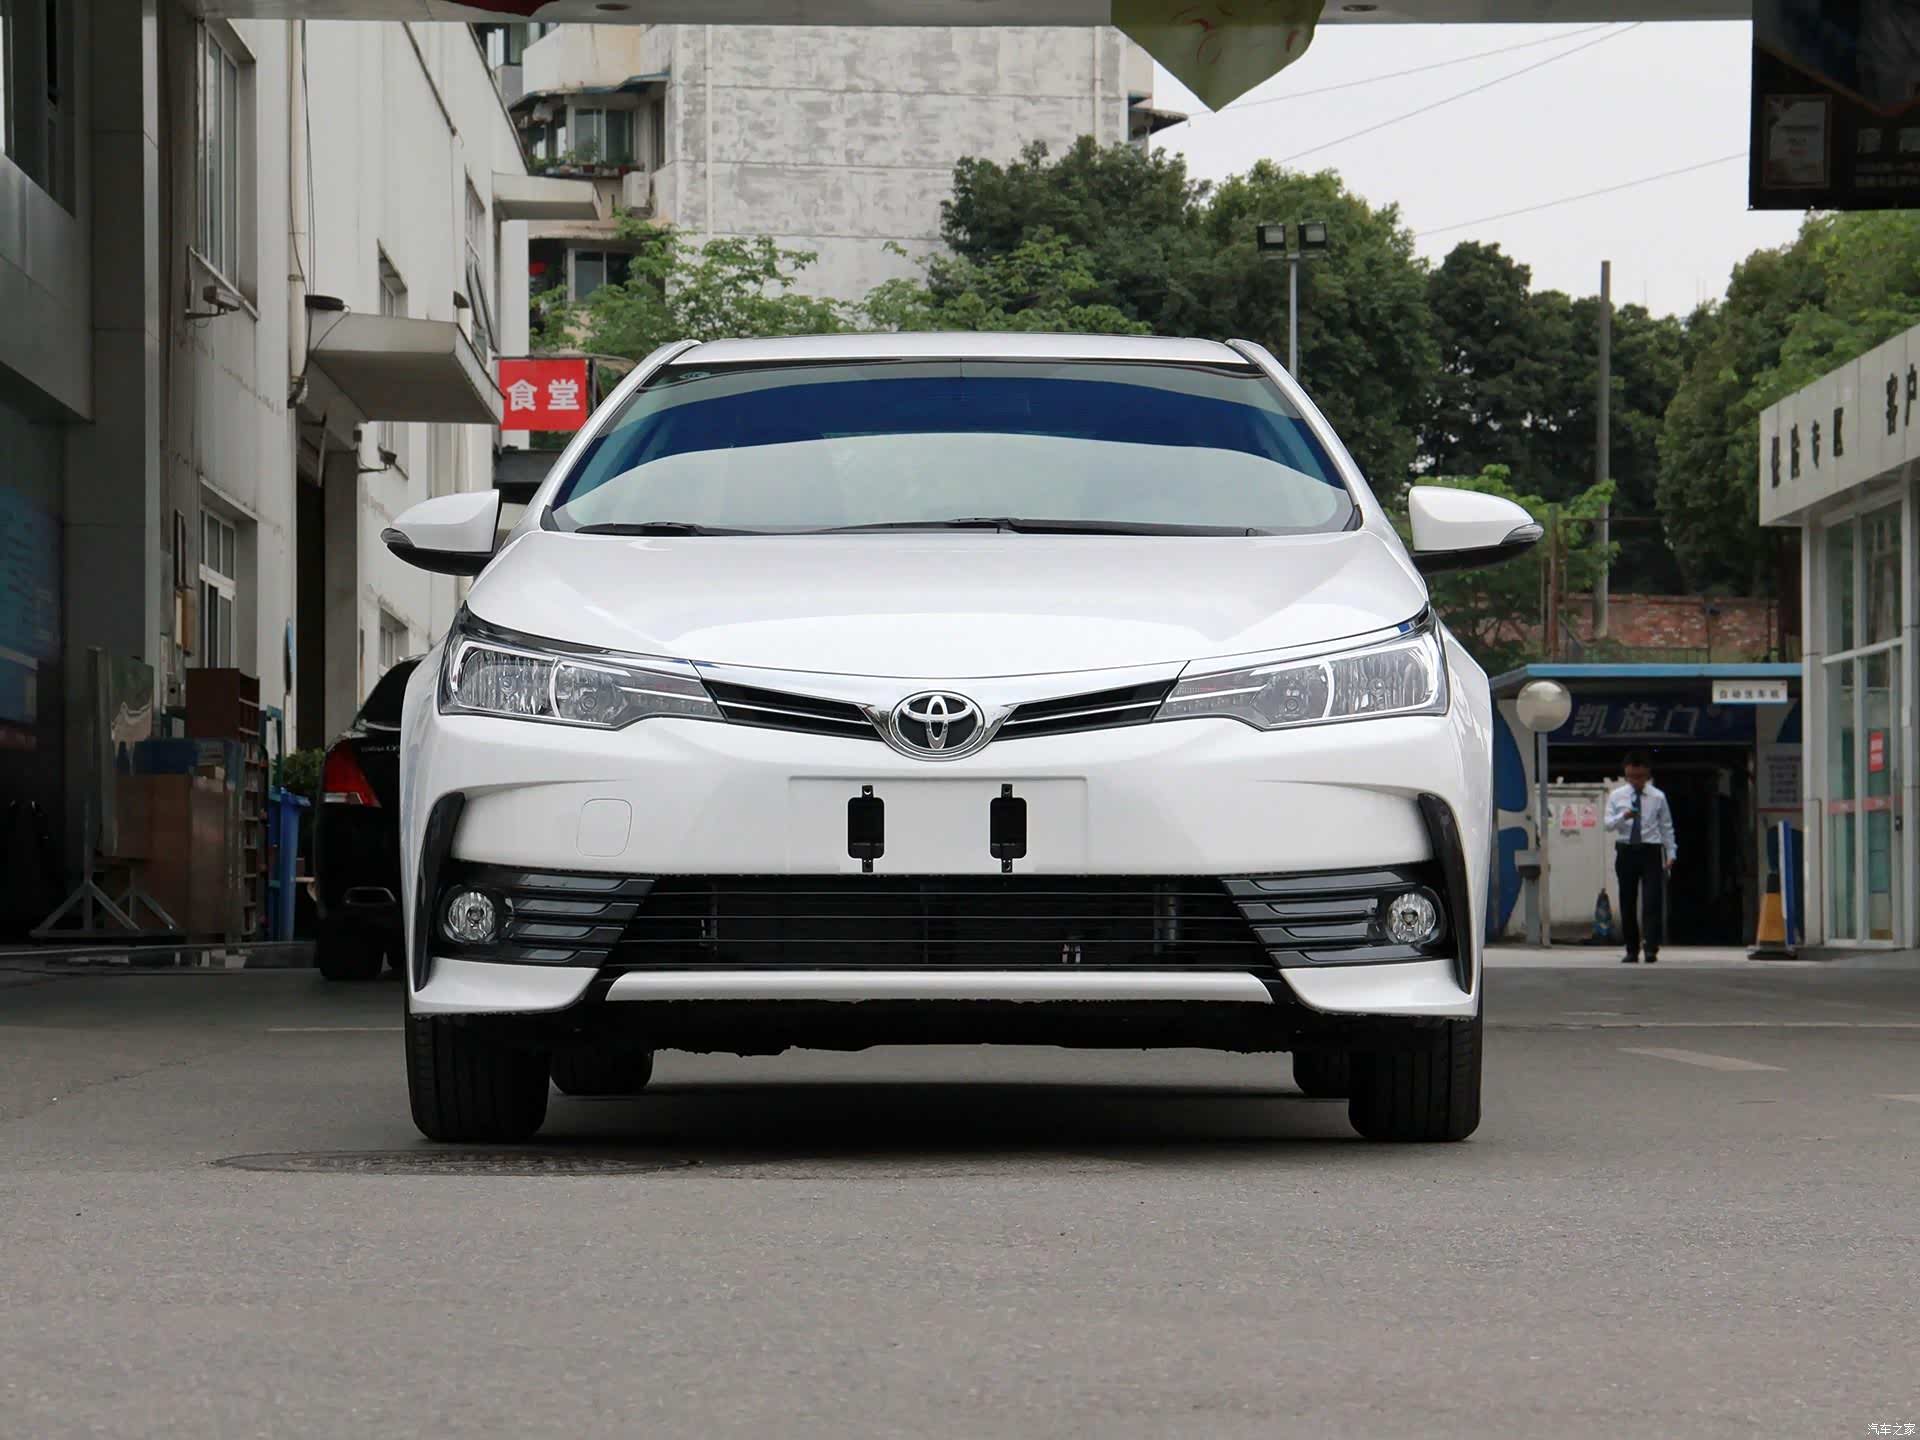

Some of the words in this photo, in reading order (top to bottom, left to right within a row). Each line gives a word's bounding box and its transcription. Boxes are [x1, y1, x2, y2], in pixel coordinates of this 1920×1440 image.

[506, 378, 580, 412] 食堂
[1571, 702, 1700, 737] 凯旋门
